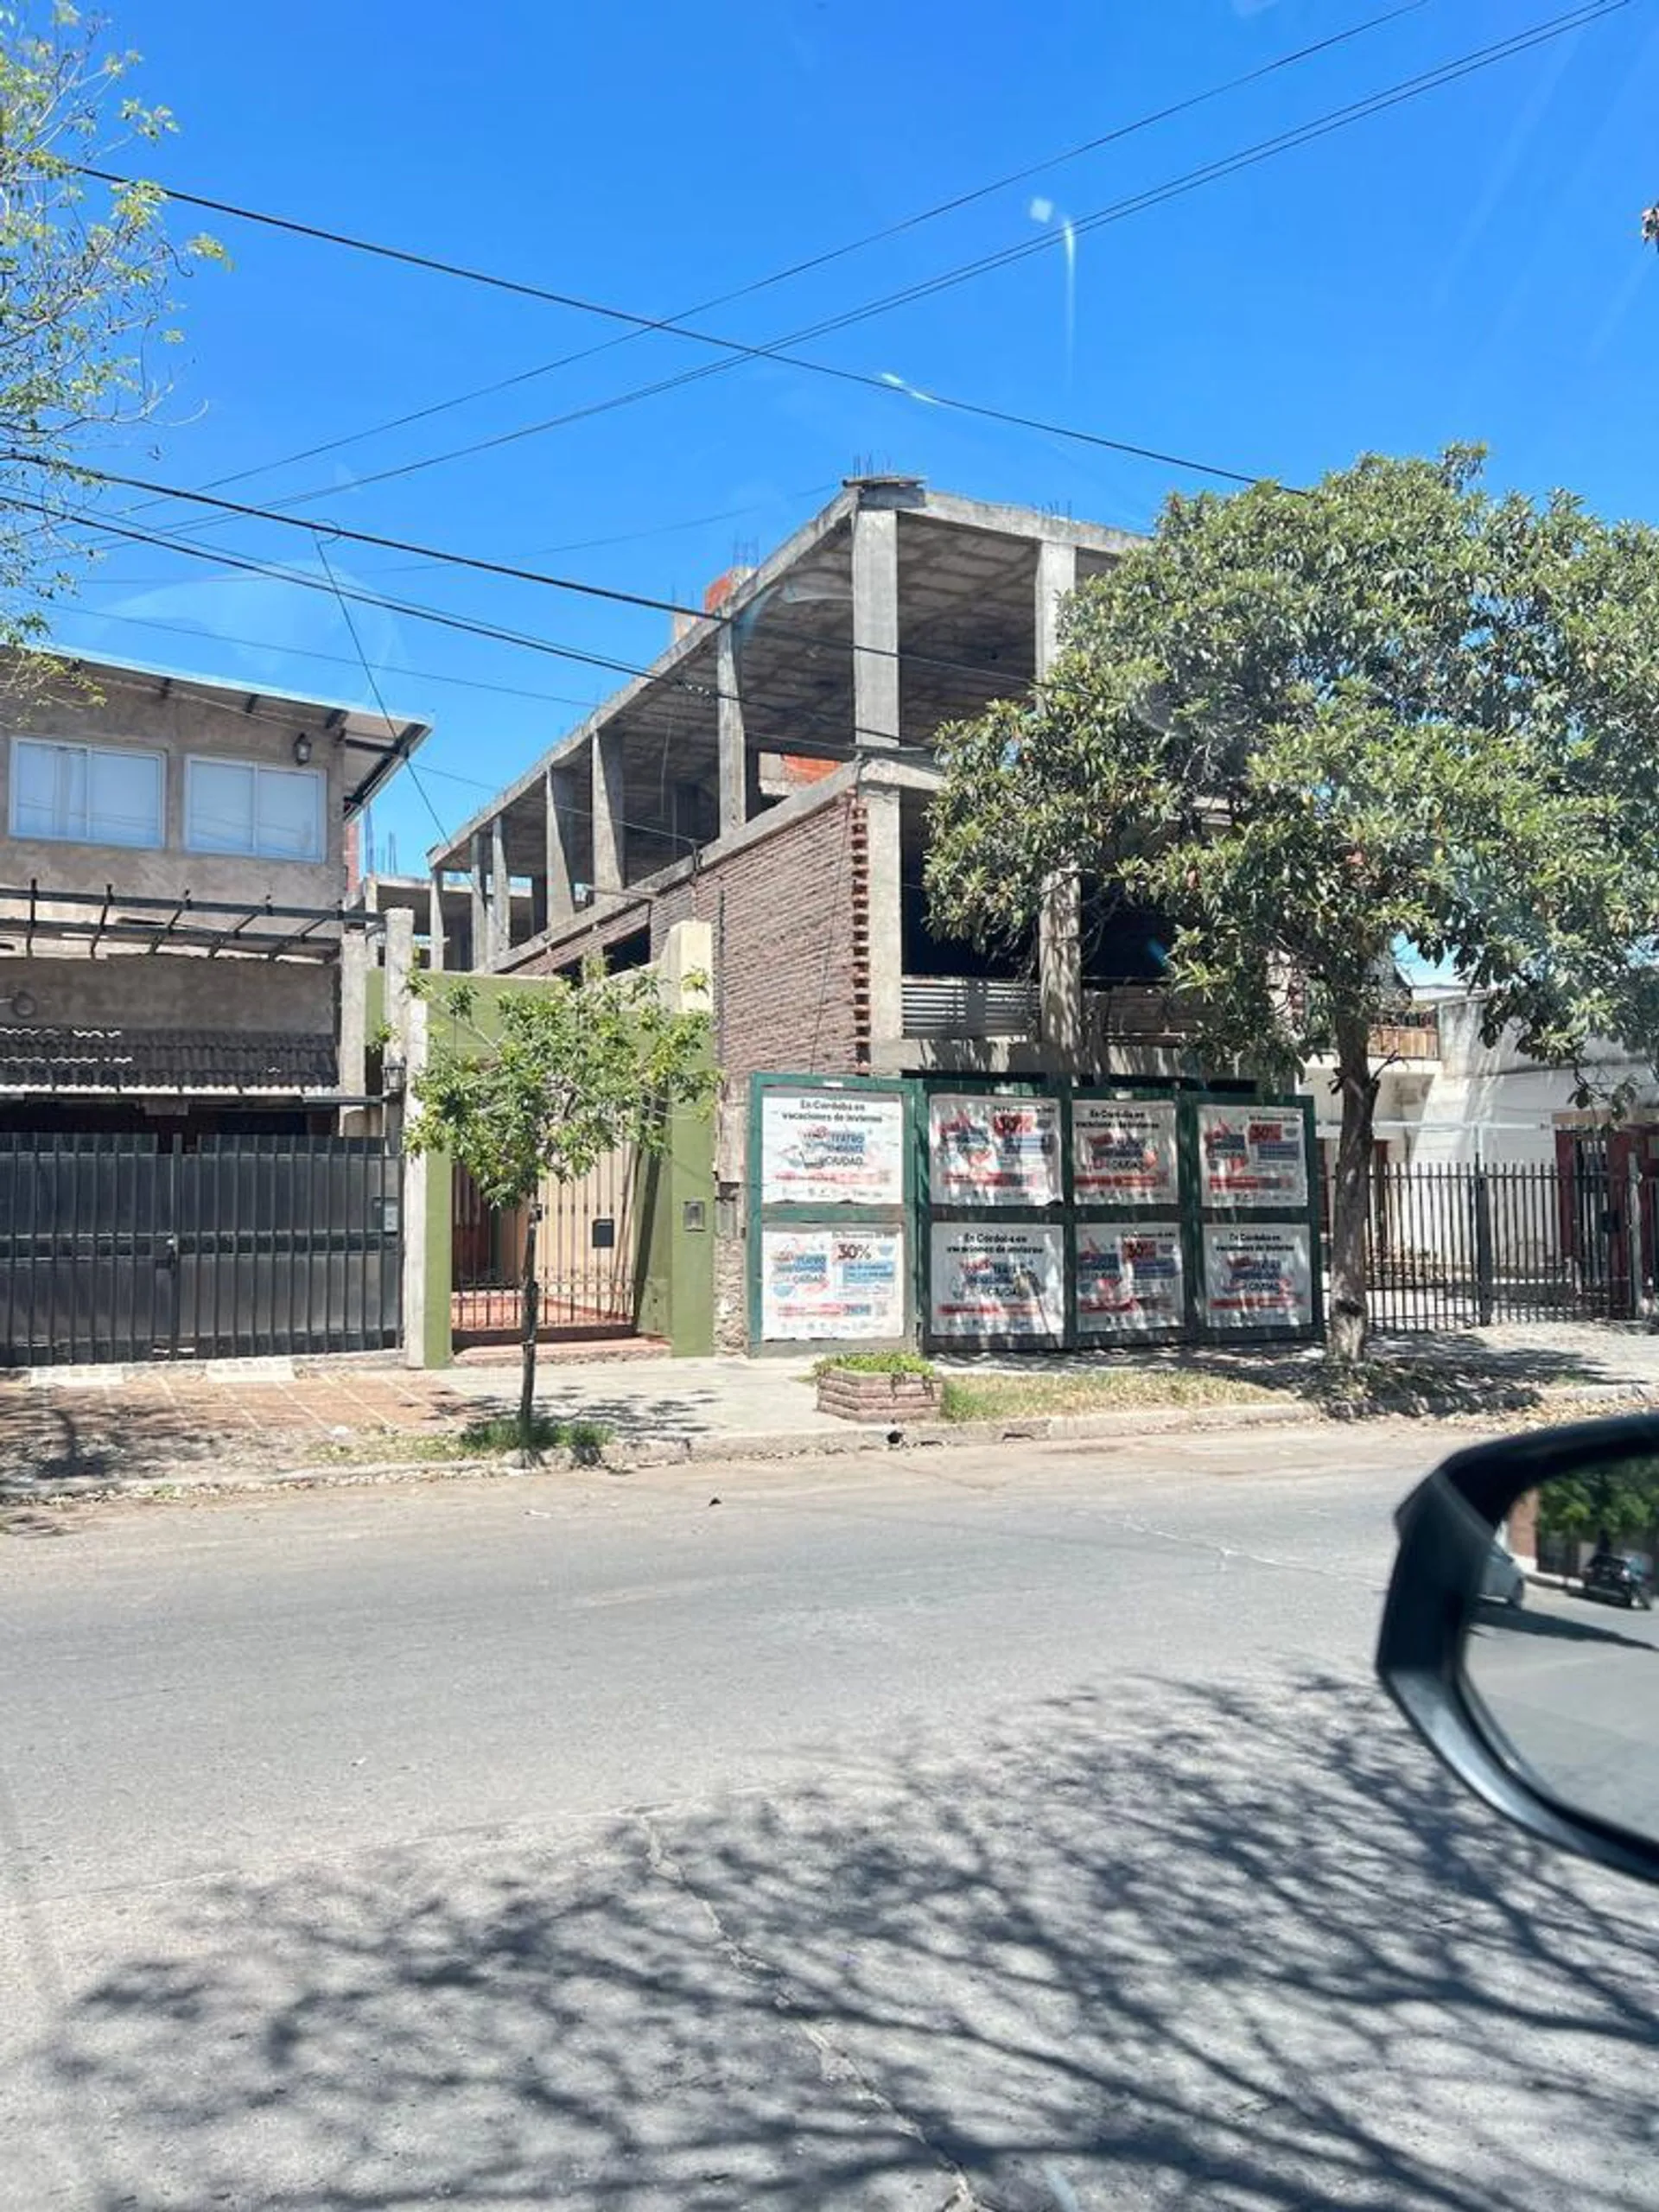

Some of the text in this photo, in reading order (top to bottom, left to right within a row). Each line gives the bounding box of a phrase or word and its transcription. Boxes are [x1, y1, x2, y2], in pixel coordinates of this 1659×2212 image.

[782, 1112, 882, 1122] vacaciones de invierno
[837, 1243, 872, 1260] 30%
